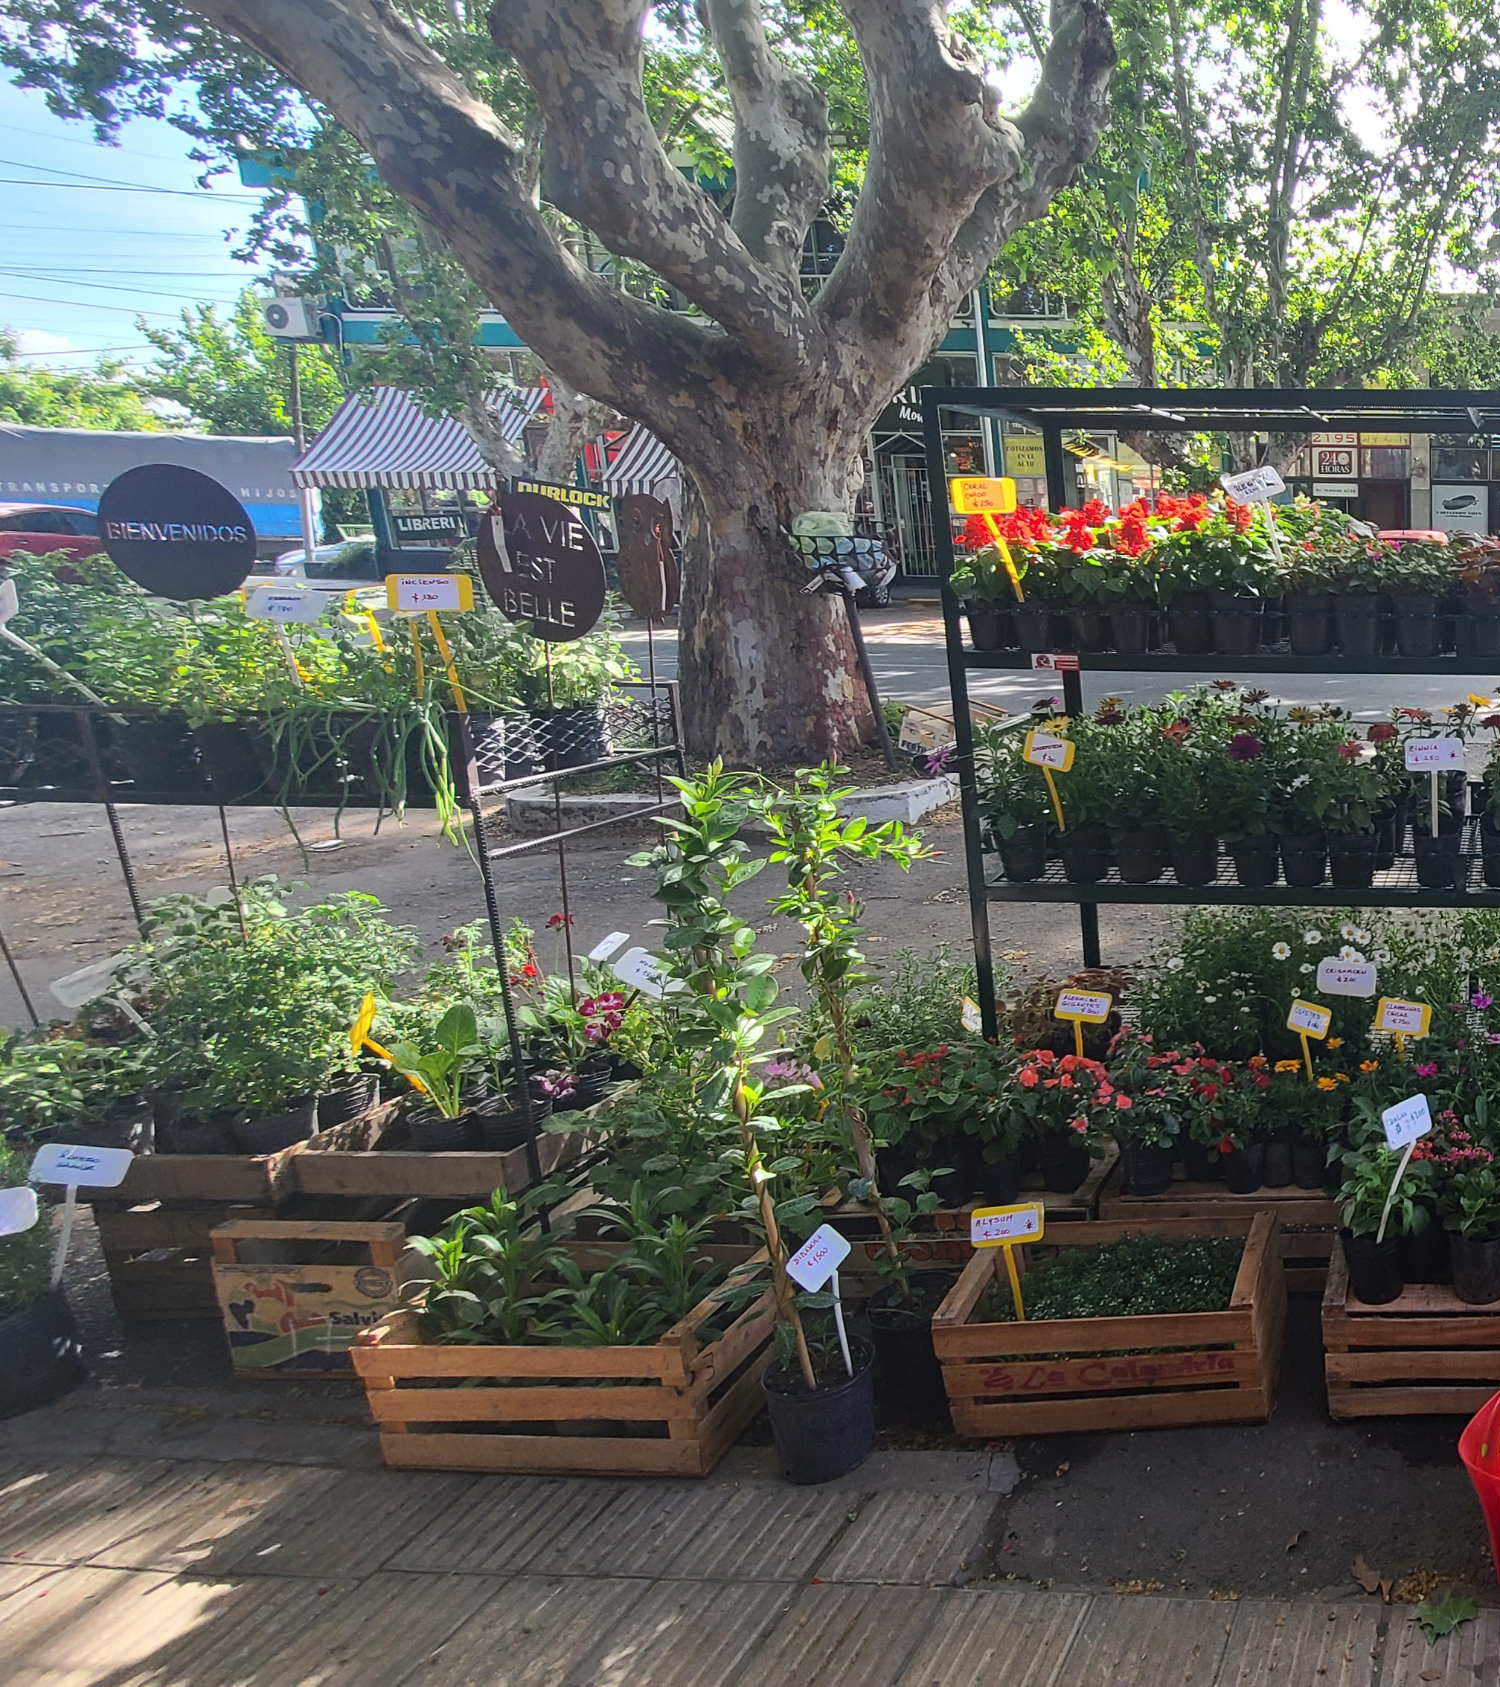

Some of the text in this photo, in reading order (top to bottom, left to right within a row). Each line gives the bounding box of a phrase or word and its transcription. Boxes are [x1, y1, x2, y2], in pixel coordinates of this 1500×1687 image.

[1312, 433, 1356, 443] 2195
[1321, 452, 1339, 466] 24
[1320, 465, 1350, 474] HORAS
[240, 487, 298, 499] HIJOS
[106, 521, 249, 544] BIENVENIDOS
[540, 516, 584, 551] VIE
[516, 549, 556, 584] EST
[503, 587, 576, 629] BELLE
